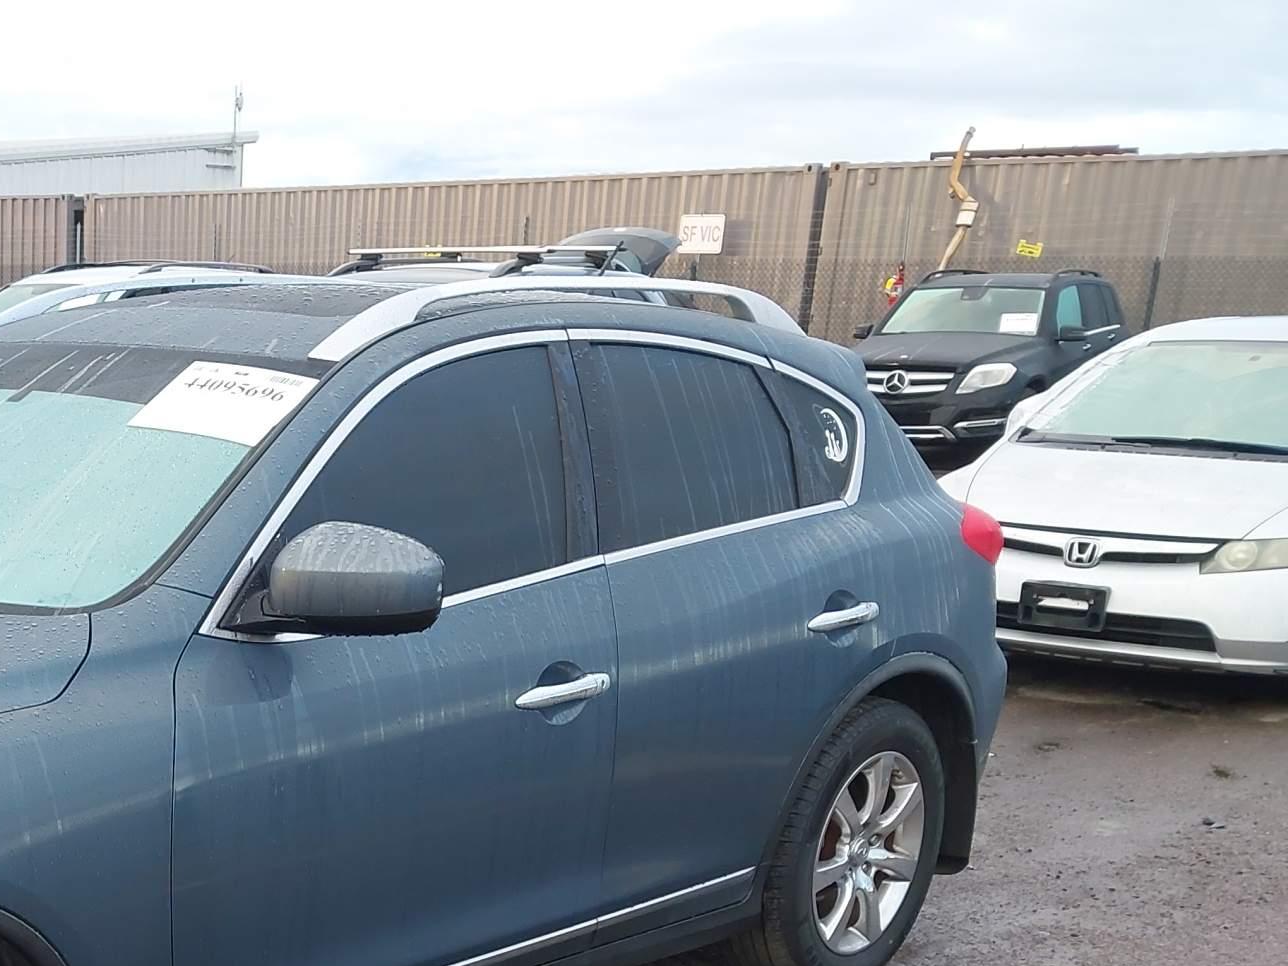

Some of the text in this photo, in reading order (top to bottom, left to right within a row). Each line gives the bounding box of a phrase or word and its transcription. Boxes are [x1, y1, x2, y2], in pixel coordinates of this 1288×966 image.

[682, 225, 721, 242] SF VIC
[184, 377, 284, 401] 44095696
